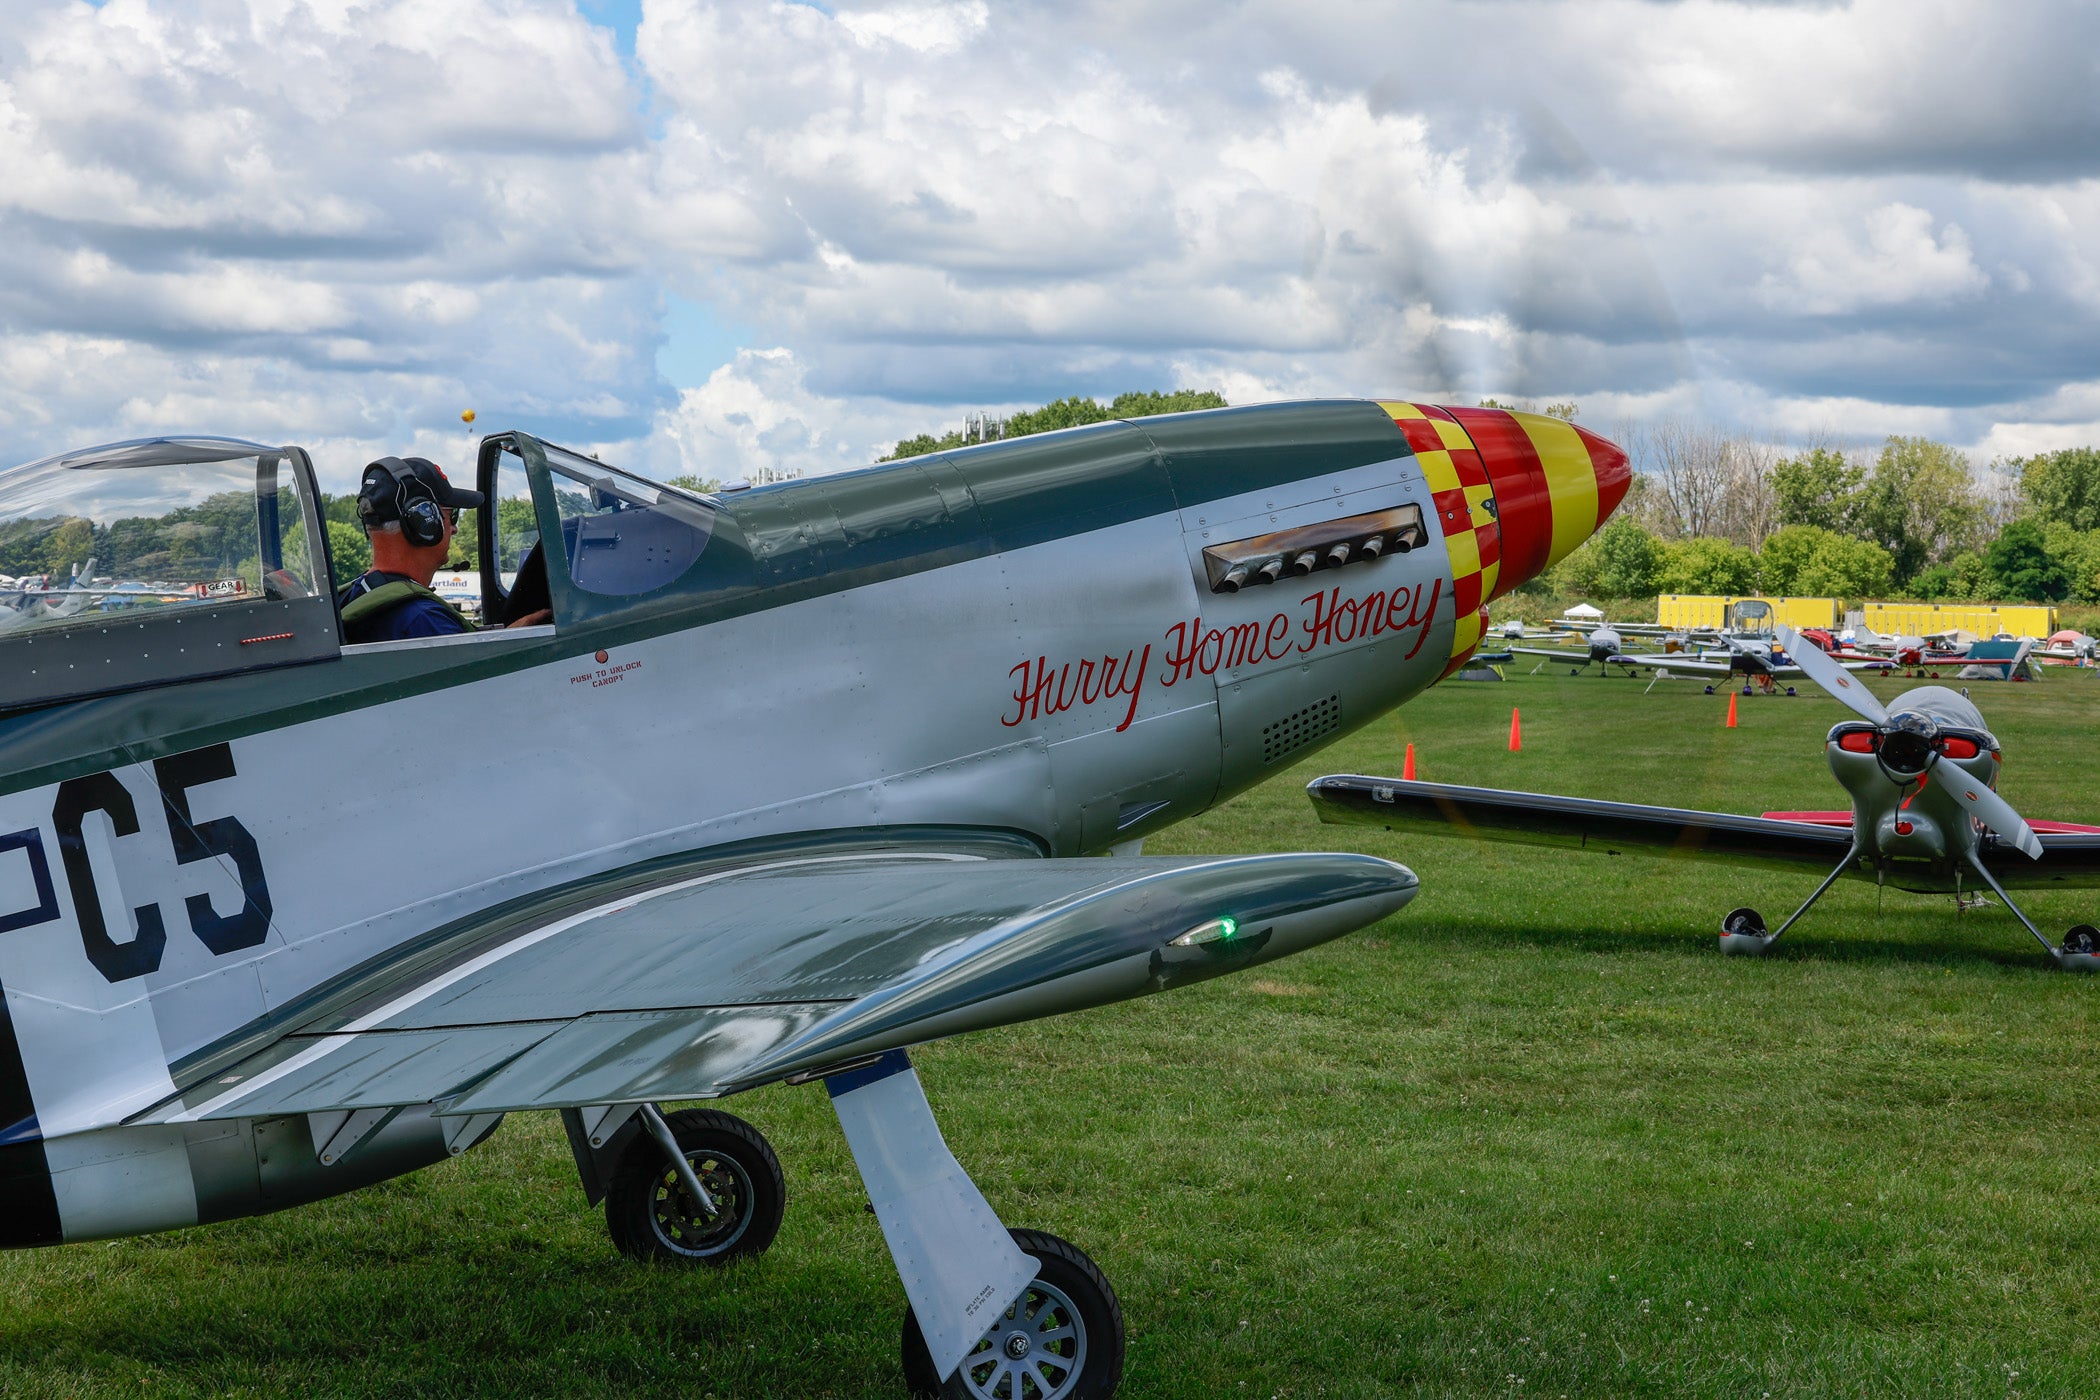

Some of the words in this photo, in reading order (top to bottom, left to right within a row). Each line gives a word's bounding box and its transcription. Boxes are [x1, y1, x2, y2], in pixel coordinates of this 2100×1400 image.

[208, 581, 234, 591] GEAR
[1001, 644, 1151, 732] Hurry
[1160, 613, 1293, 687] Home
[1298, 578, 1442, 660] Honey
[570, 673, 592, 685] PUSH
[595, 669, 607, 678] TO
[609, 660, 642, 675] UNLOCK
[592, 674, 624, 688] CANOPY
[52, 741, 273, 984] C5
